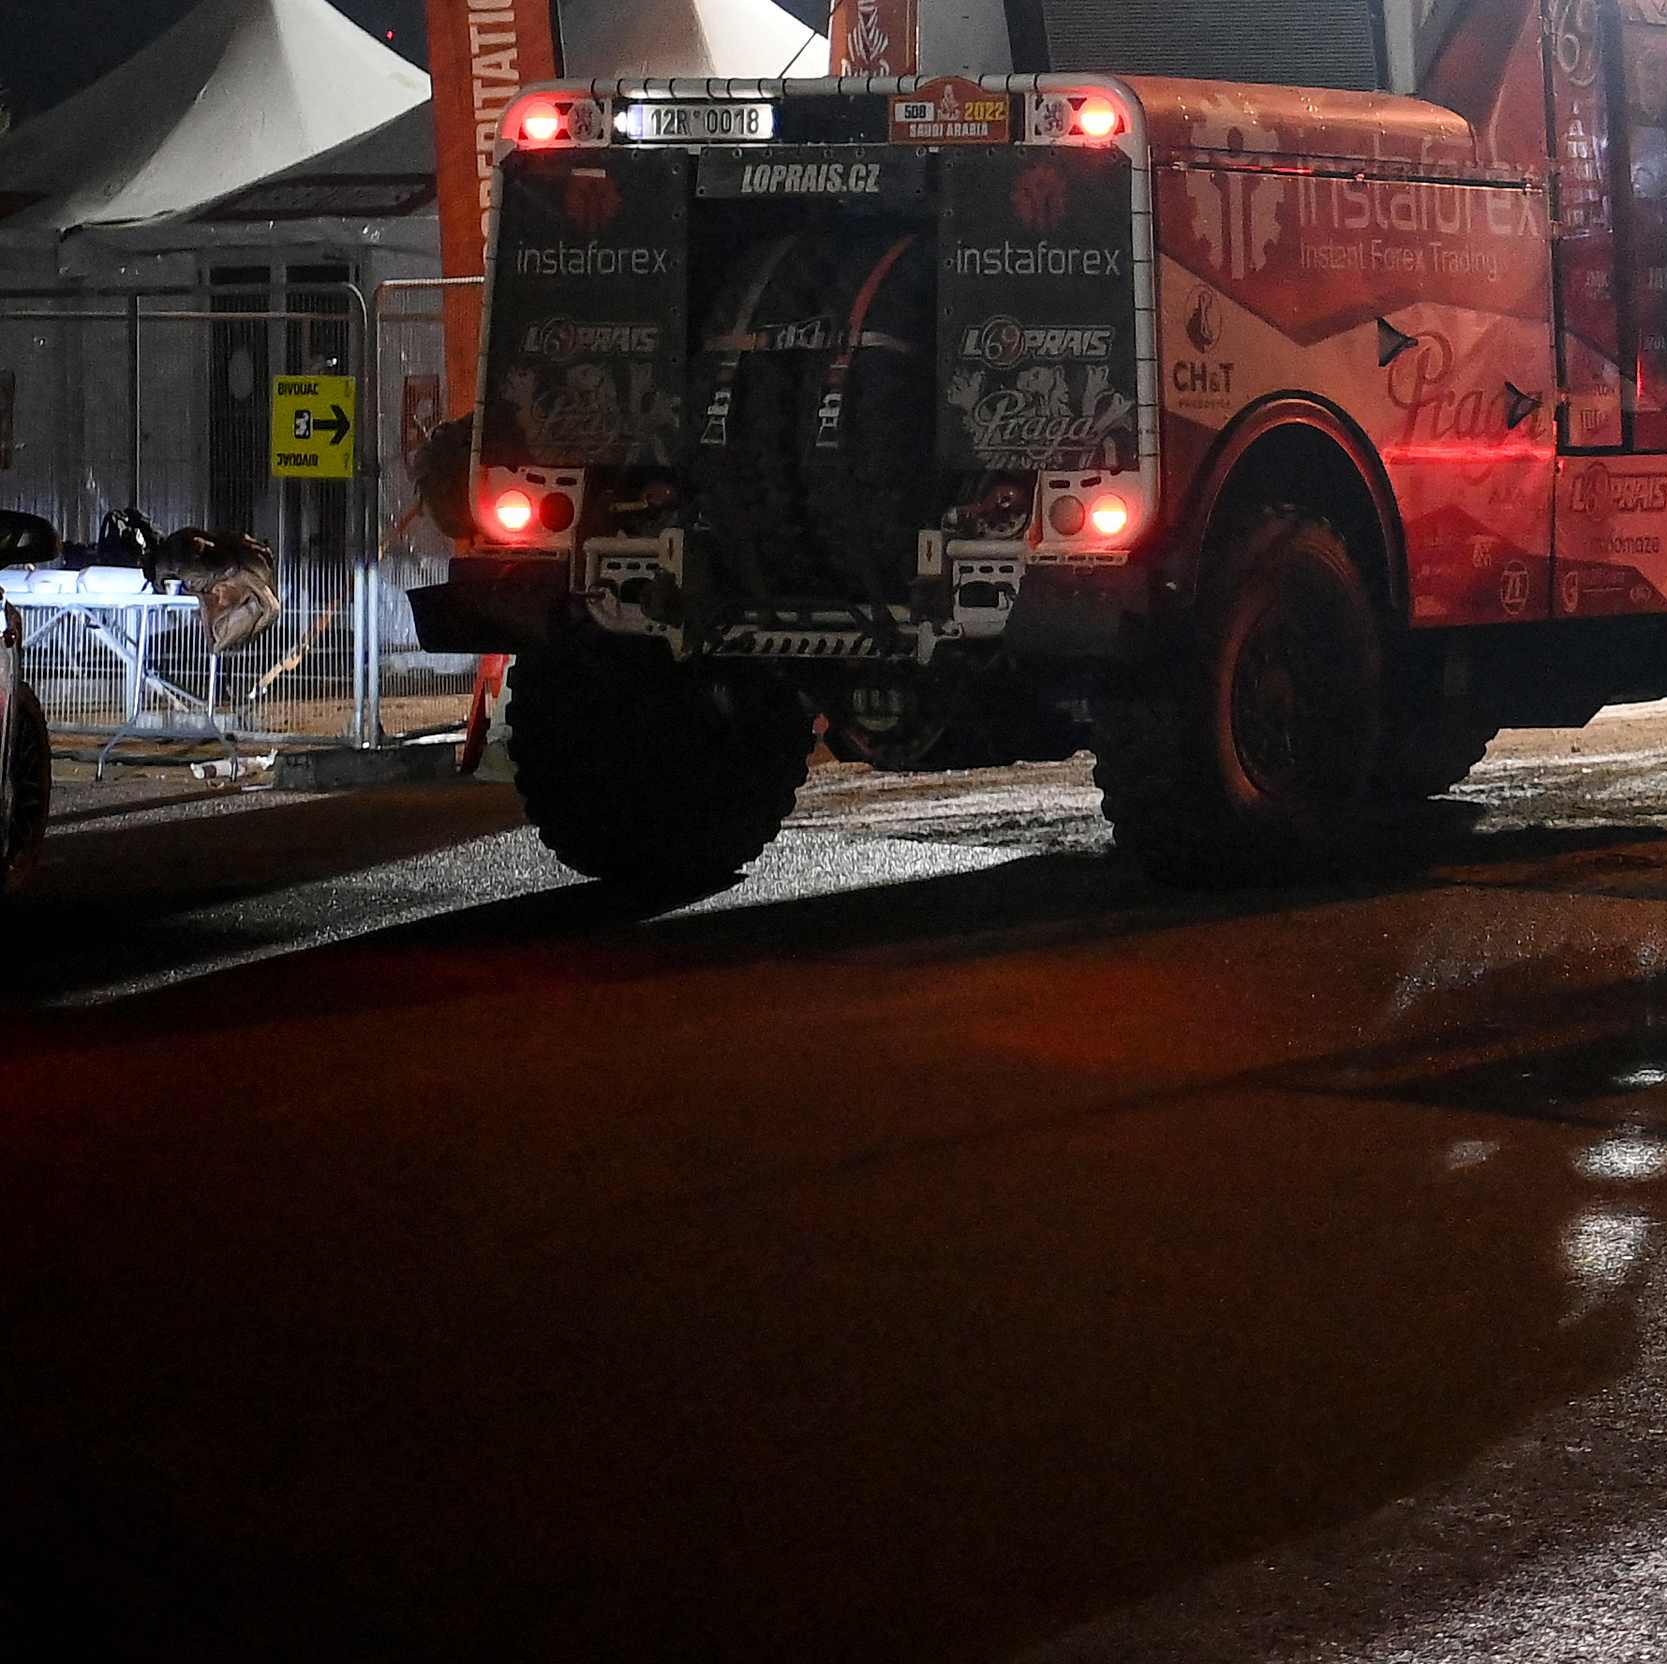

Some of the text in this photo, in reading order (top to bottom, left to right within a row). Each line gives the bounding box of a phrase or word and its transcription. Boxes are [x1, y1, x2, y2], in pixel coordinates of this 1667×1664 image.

[651, 108, 760, 136] 12R 0018
[964, 101, 1007, 121] 2022
[949, 121, 989, 137] ARABIA
[741, 163, 880, 194] LOPRAIS.CZ
[515, 240, 669, 275] instaforex
[956, 239, 1121, 276] instaforex
[277, 382, 319, 396] BIVOUAC
